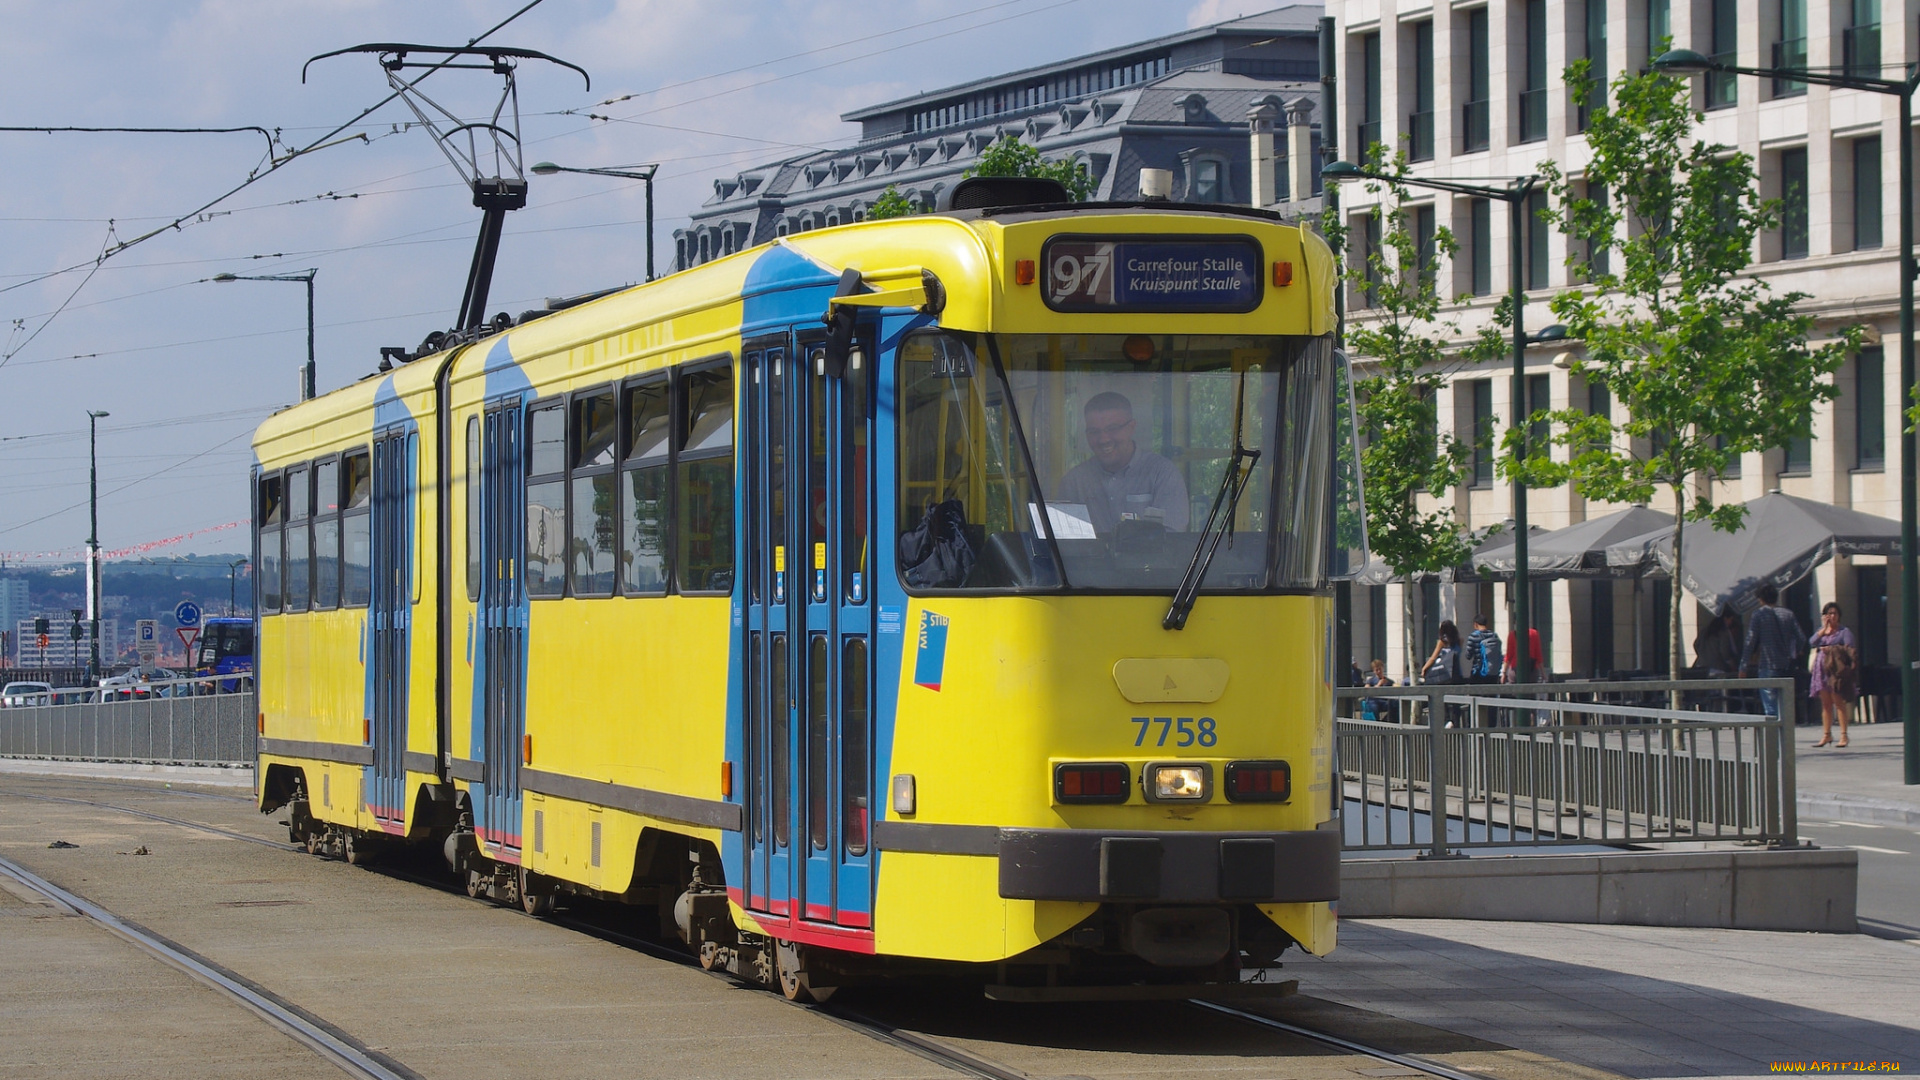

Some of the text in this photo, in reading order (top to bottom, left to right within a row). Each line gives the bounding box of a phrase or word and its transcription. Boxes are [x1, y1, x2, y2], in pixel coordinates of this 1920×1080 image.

[1127, 257, 1243, 274] Carrefour Stalle
[1053, 254, 1110, 296] 97
[1129, 276, 1241, 291] Kruispunt Stalle
[930, 614, 949, 627] STIB
[1131, 716, 1218, 748] 7758
